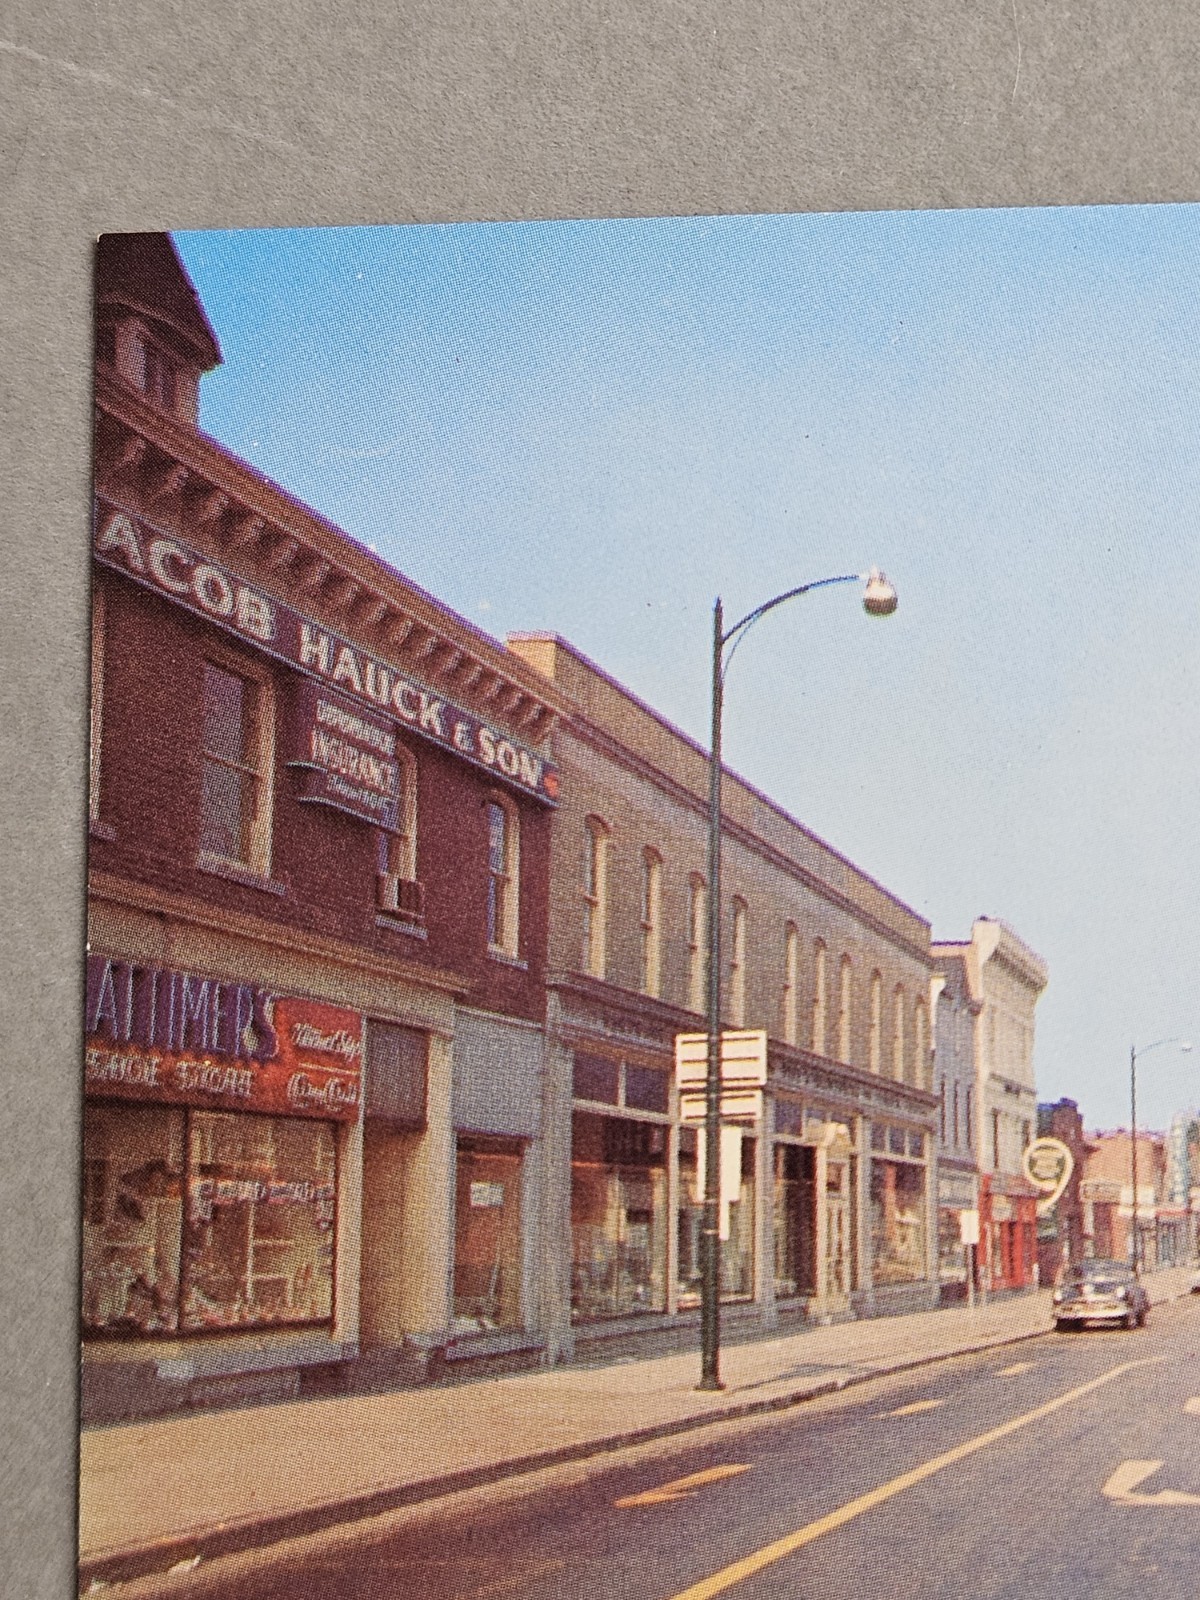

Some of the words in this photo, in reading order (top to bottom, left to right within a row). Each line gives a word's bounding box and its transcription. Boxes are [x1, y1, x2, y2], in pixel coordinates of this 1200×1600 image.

[100, 513, 276, 641] ACOB
[300, 623, 446, 736] HAUCK
[478, 728, 545, 788] SON
